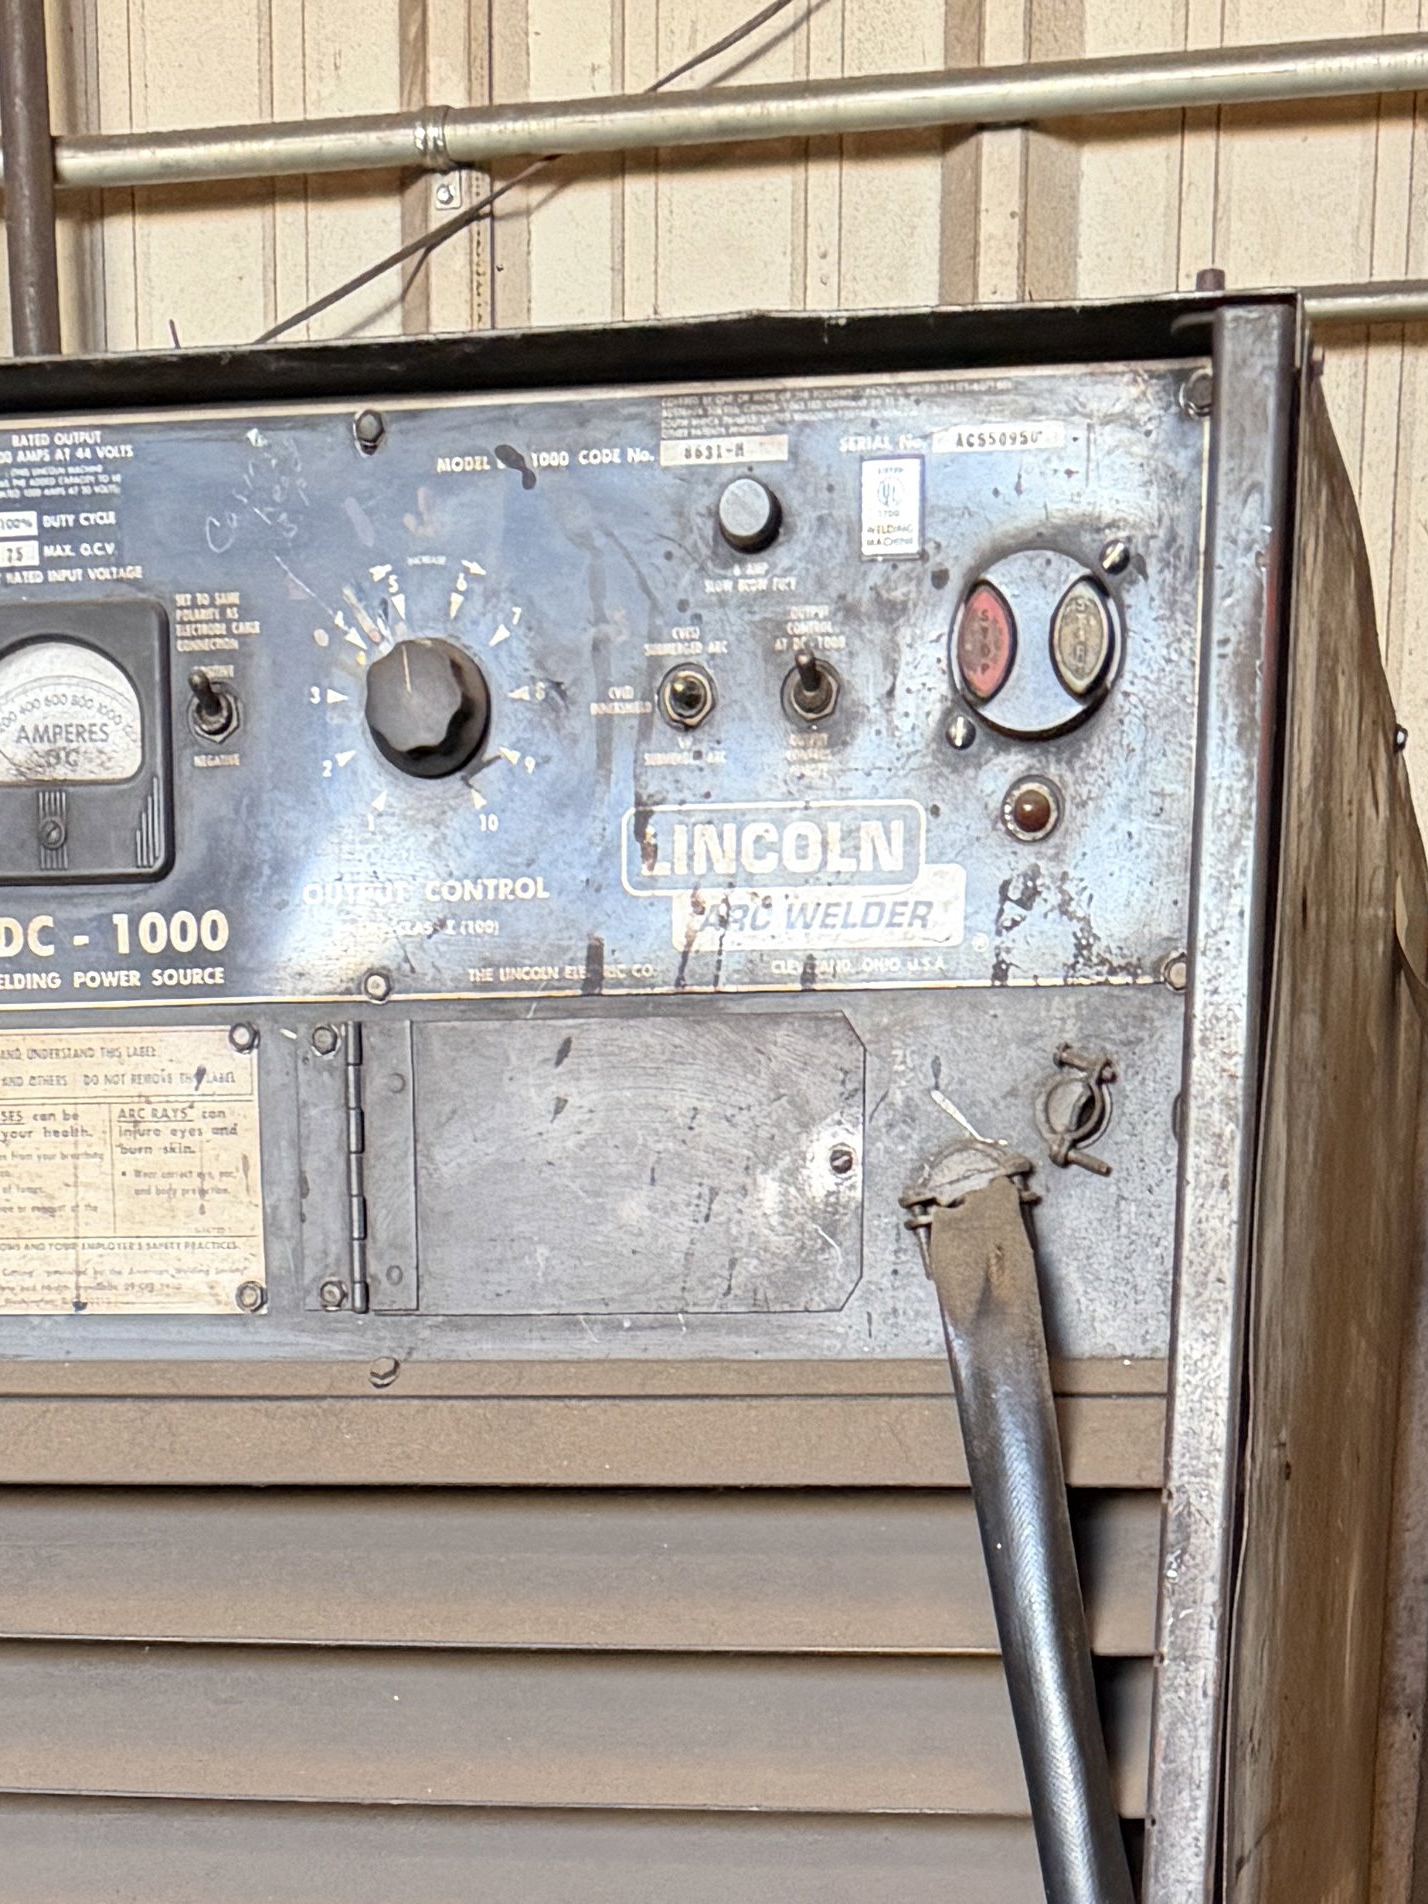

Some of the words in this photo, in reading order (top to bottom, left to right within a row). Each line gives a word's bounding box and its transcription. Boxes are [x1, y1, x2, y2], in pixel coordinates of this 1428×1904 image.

[12, 434, 49, 447] RATED
[54, 431, 102, 446] OUTPUT
[17, 449, 51, 462] AMPS
[54, 448, 71, 462] AT
[95, 445, 135, 459] VOLTS
[436, 456, 490, 474] MODEL
[578, 448, 620, 466] CODE
[627, 447, 655, 463] No.
[0, 517, 33, 531] 100%
[42, 514, 76, 528] DUTY
[79, 511, 117, 525] CYCLE
[47, 568, 84, 582] INPUT
[87, 566, 144, 580] VOLTAGE
[309, 686, 323, 704] 3
[15, 722, 110, 745] AMPERES
[322, 759, 333, 778] 2
[479, 813, 500, 832] 10
[641, 820, 905, 877] LINCOLN
[425, 876, 550, 902] CONTROL
[785, 899, 935, 929] WELDER
[112, 908, 230, 956] 1000
[73, 967, 141, 989] POWER
[151, 966, 227, 987] SOURCE
[468, 966, 494, 982] THE
[500, 965, 560, 981] LINCOLN
[117, 1108, 146, 1121] ARC
[151, 1107, 190, 1120] RAYS
